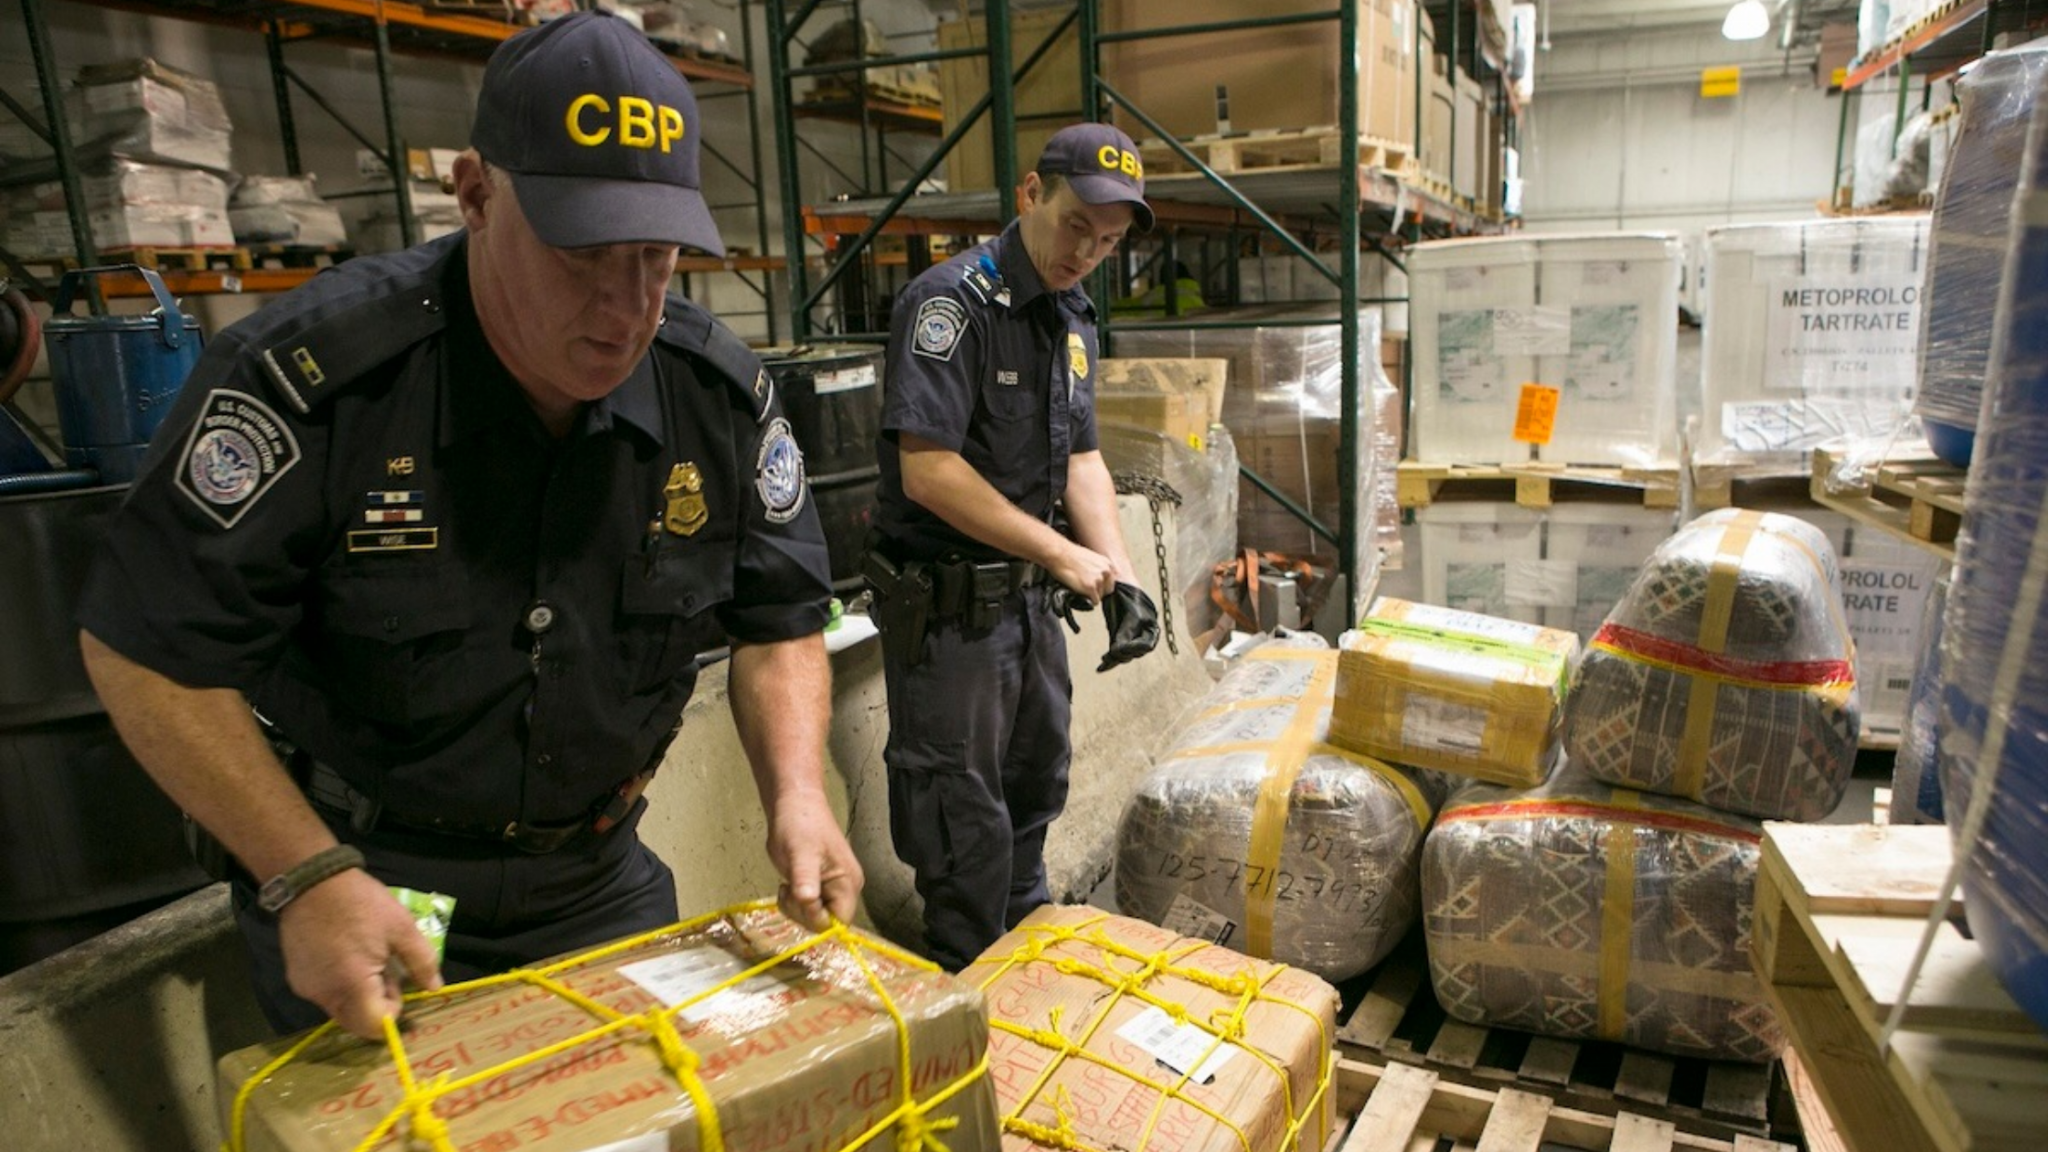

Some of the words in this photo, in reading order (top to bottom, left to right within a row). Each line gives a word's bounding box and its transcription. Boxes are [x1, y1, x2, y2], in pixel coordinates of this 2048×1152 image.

[565, 93, 684, 153] CBP
[1098, 145, 1143, 181] CBP
[1801, 313, 1910, 331] TARTRATE
